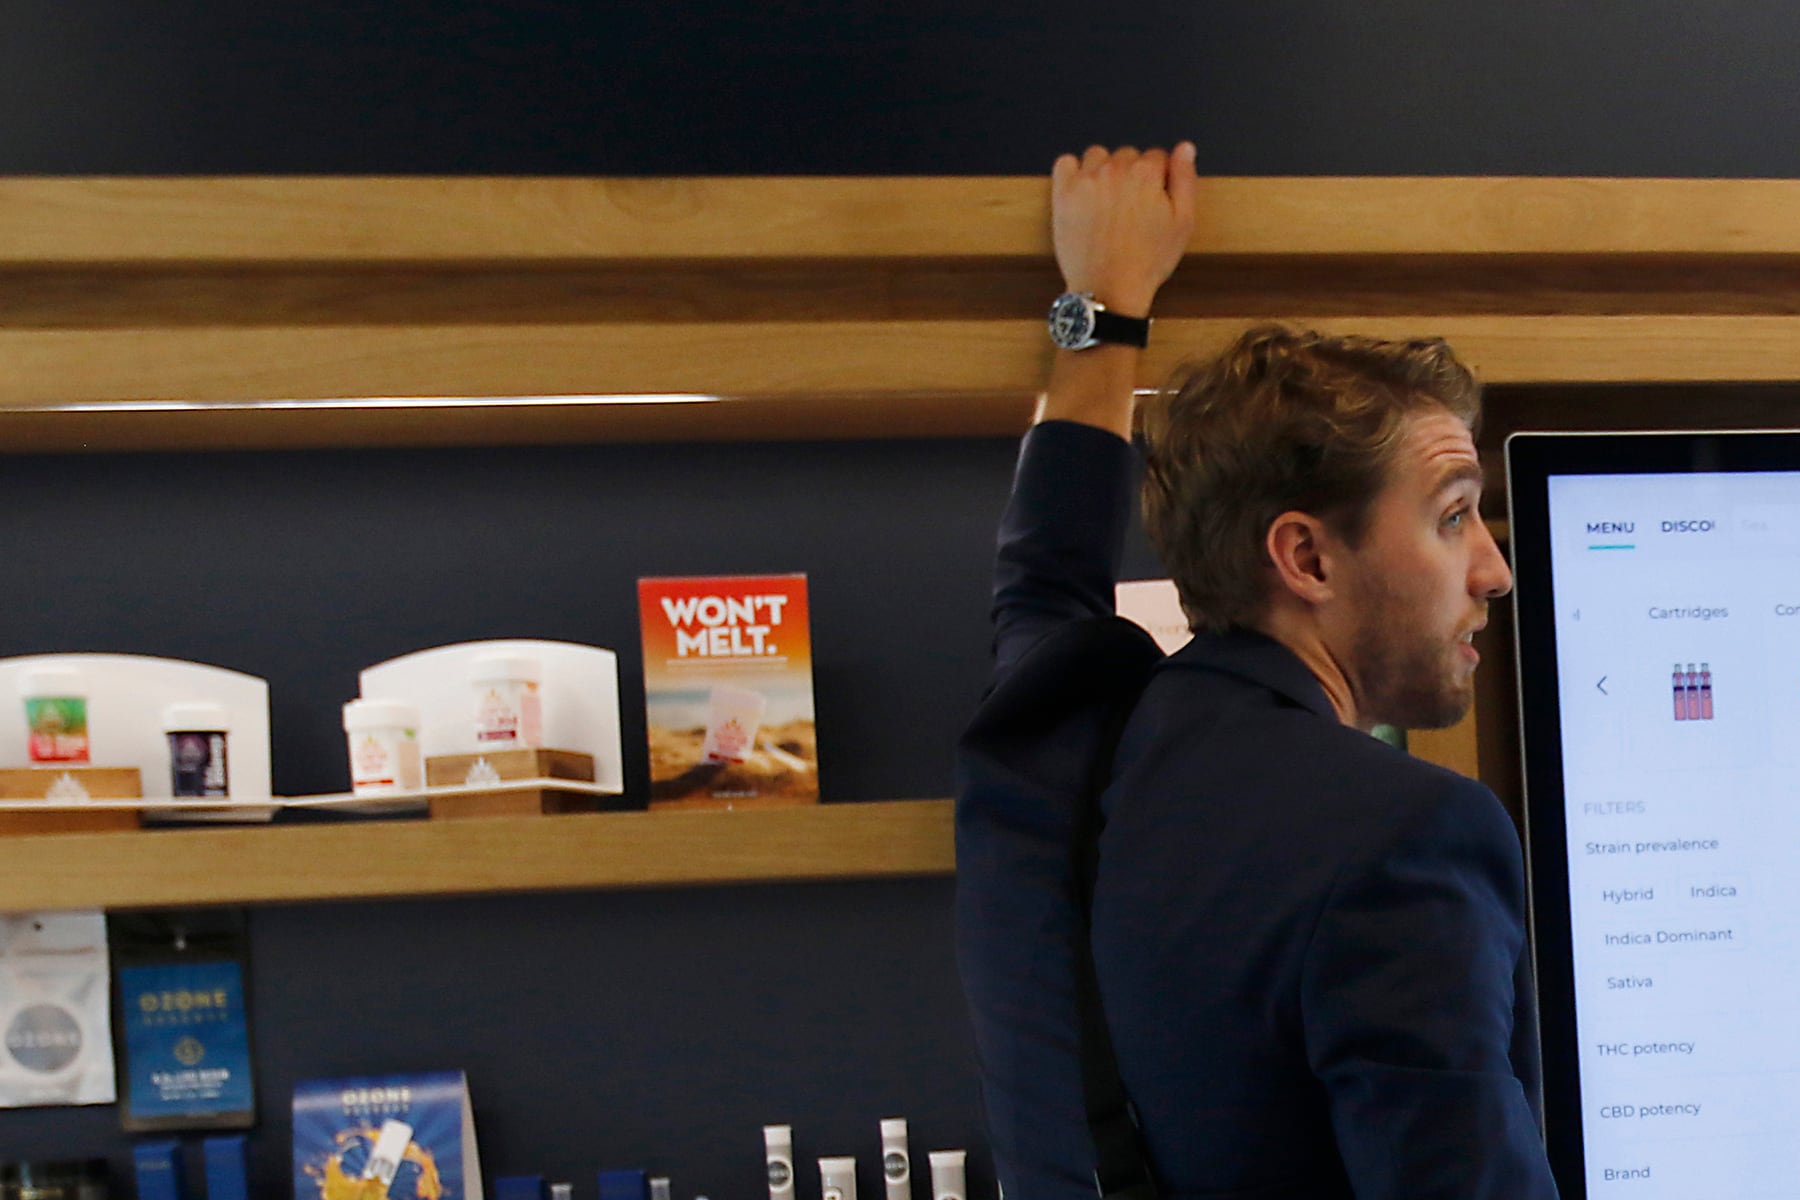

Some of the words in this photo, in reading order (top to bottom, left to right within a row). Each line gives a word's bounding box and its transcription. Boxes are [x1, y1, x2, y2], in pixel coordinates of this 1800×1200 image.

[1587, 522, 1635, 534] MENU
[1661, 520, 1715, 533] DISCO
[661, 595, 788, 627] WON'T
[1648, 604, 1729, 622] Cartridges
[676, 626, 777, 656] MELT.
[1583, 800, 1646, 816] FILTERS
[1586, 841, 1630, 855] Strain
[1635, 837, 1719, 855] prevalence
[1602, 888, 1654, 905] Hybrid
[1690, 885, 1737, 898] Indica
[1605, 932, 1652, 946] Indica
[1656, 928, 1733, 944] Dominant
[1607, 976, 1653, 990] Sativa
[1597, 1043, 1630, 1056] THC
[1633, 1041, 1695, 1058] potency
[1600, 1106, 1635, 1119] CBD
[1639, 1103, 1701, 1118] potency
[1604, 1166, 1650, 1181] Brand
